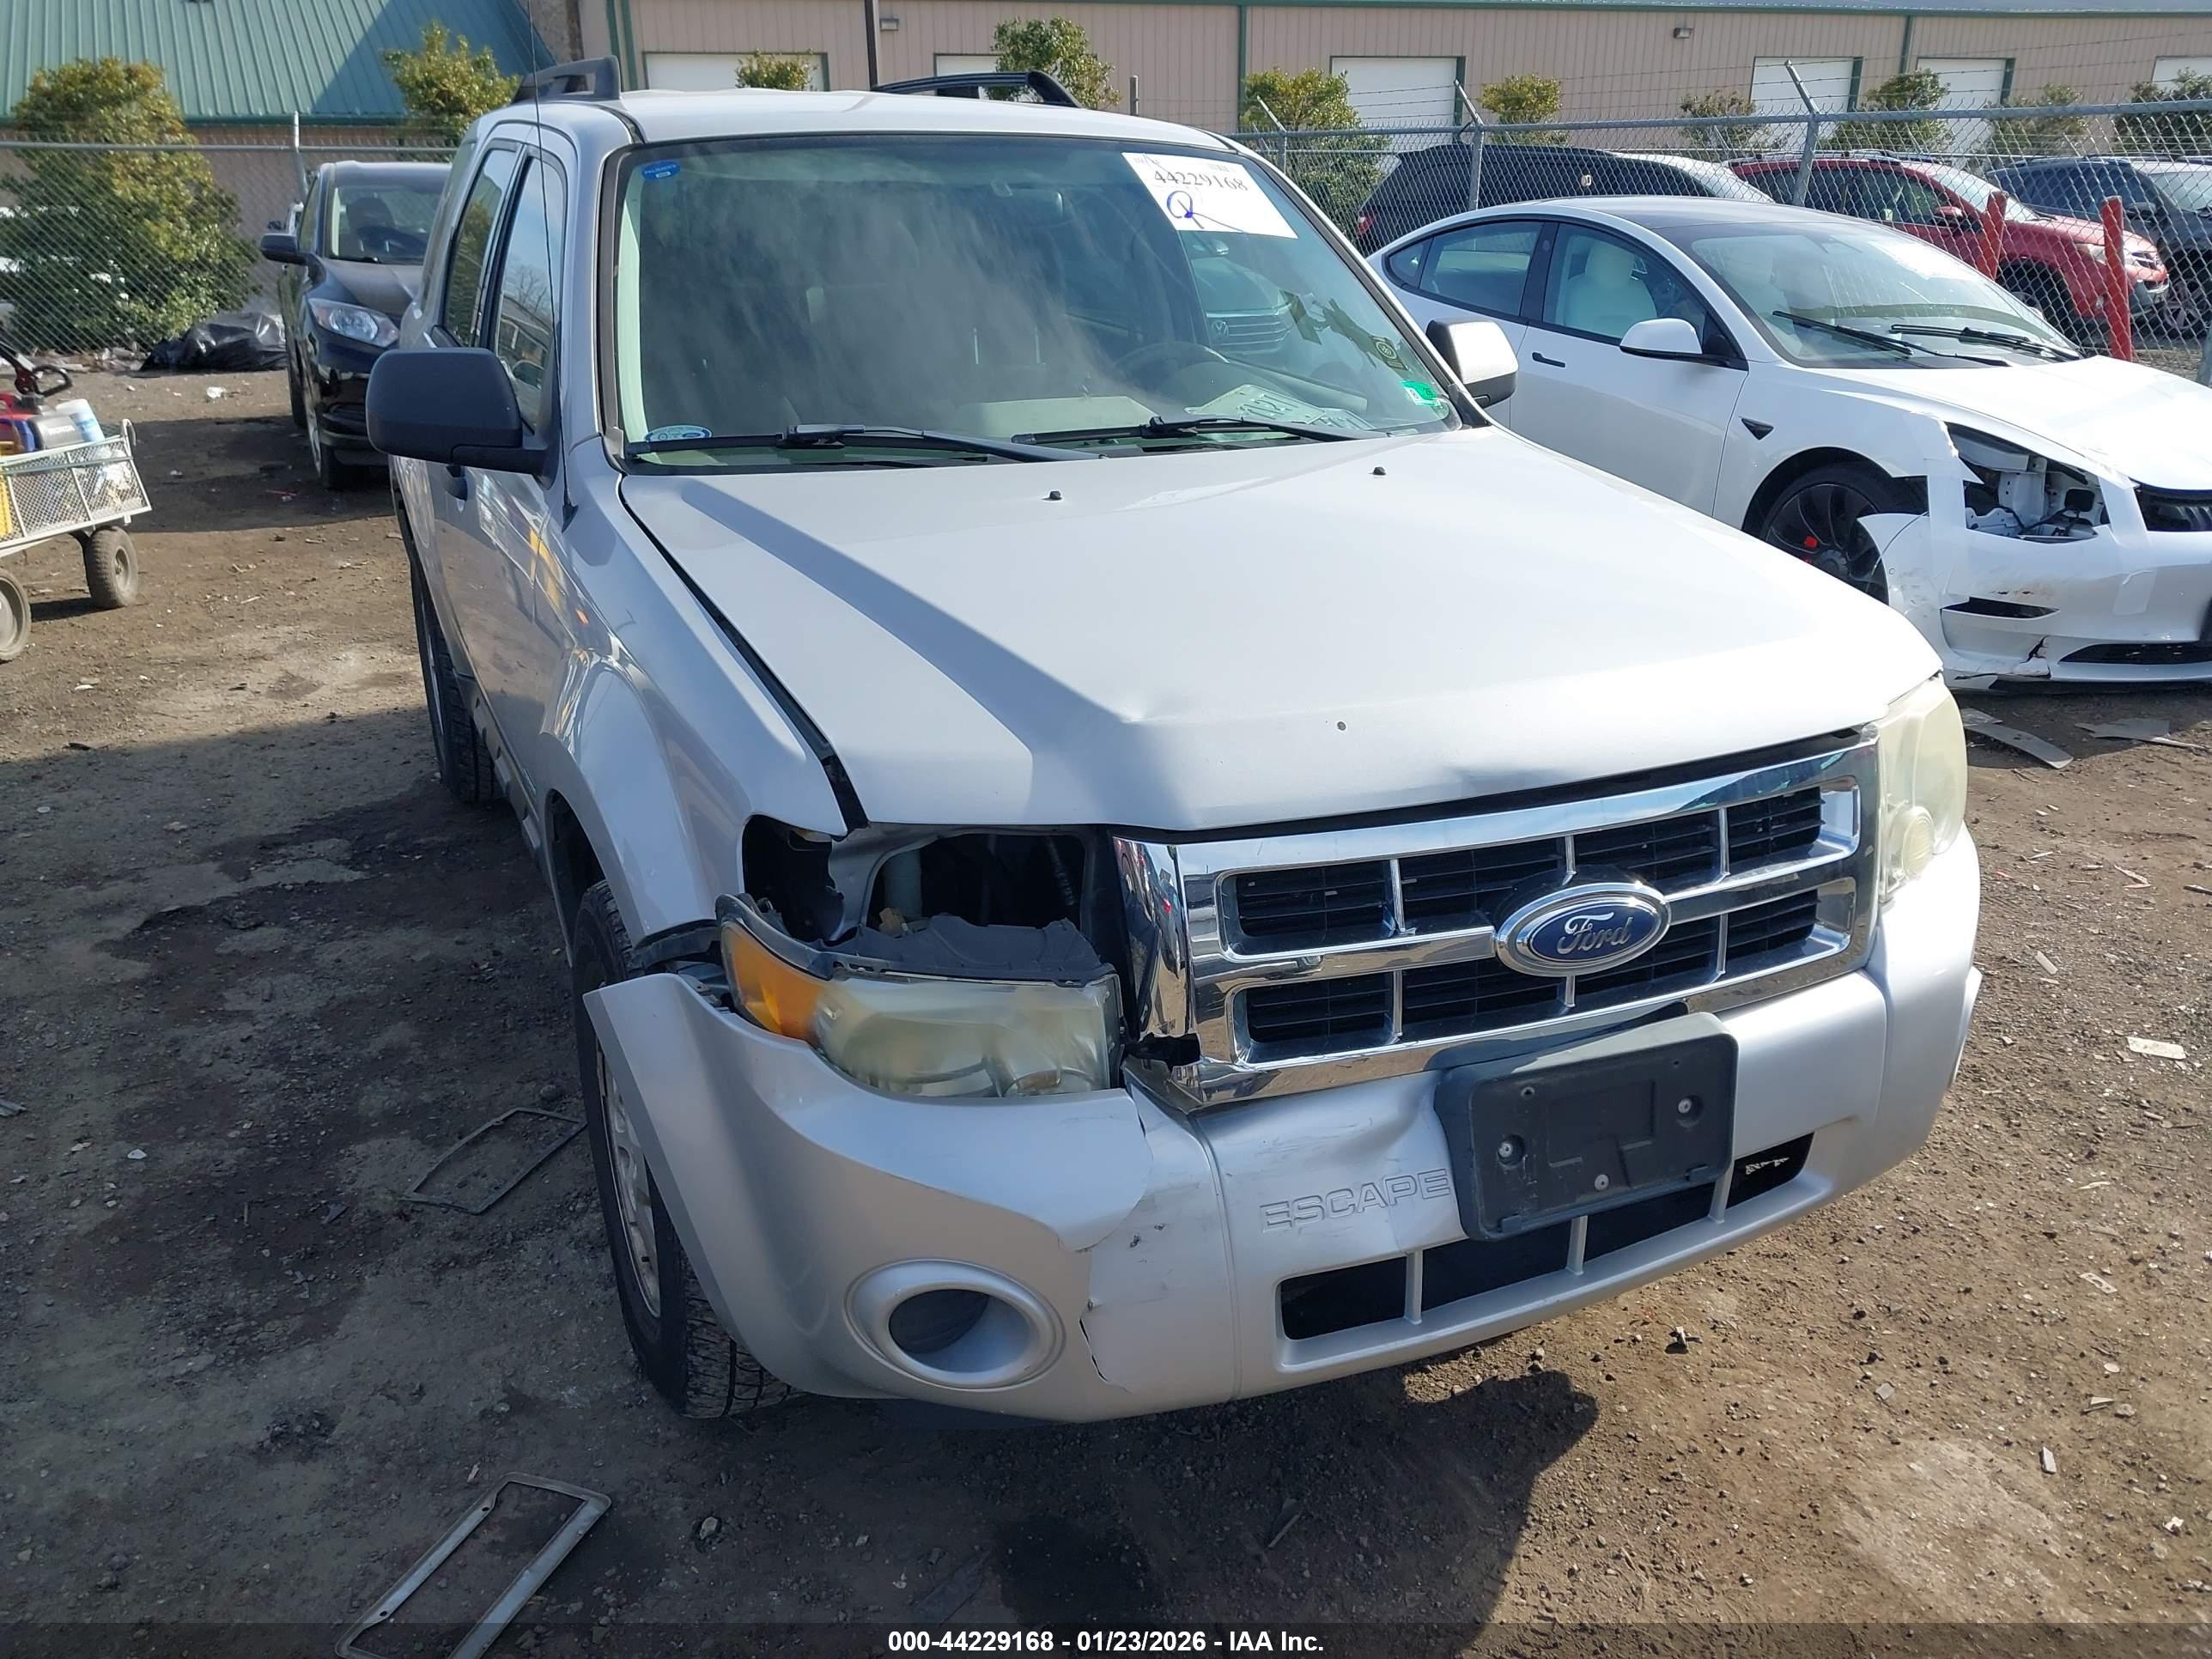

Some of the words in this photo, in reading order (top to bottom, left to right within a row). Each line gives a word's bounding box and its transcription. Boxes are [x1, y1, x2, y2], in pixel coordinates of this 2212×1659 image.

[1154, 170, 1249, 191] 44229168
[1557, 912, 1633, 954] Ford
[1259, 1168, 1451, 1234] ESCAPE
